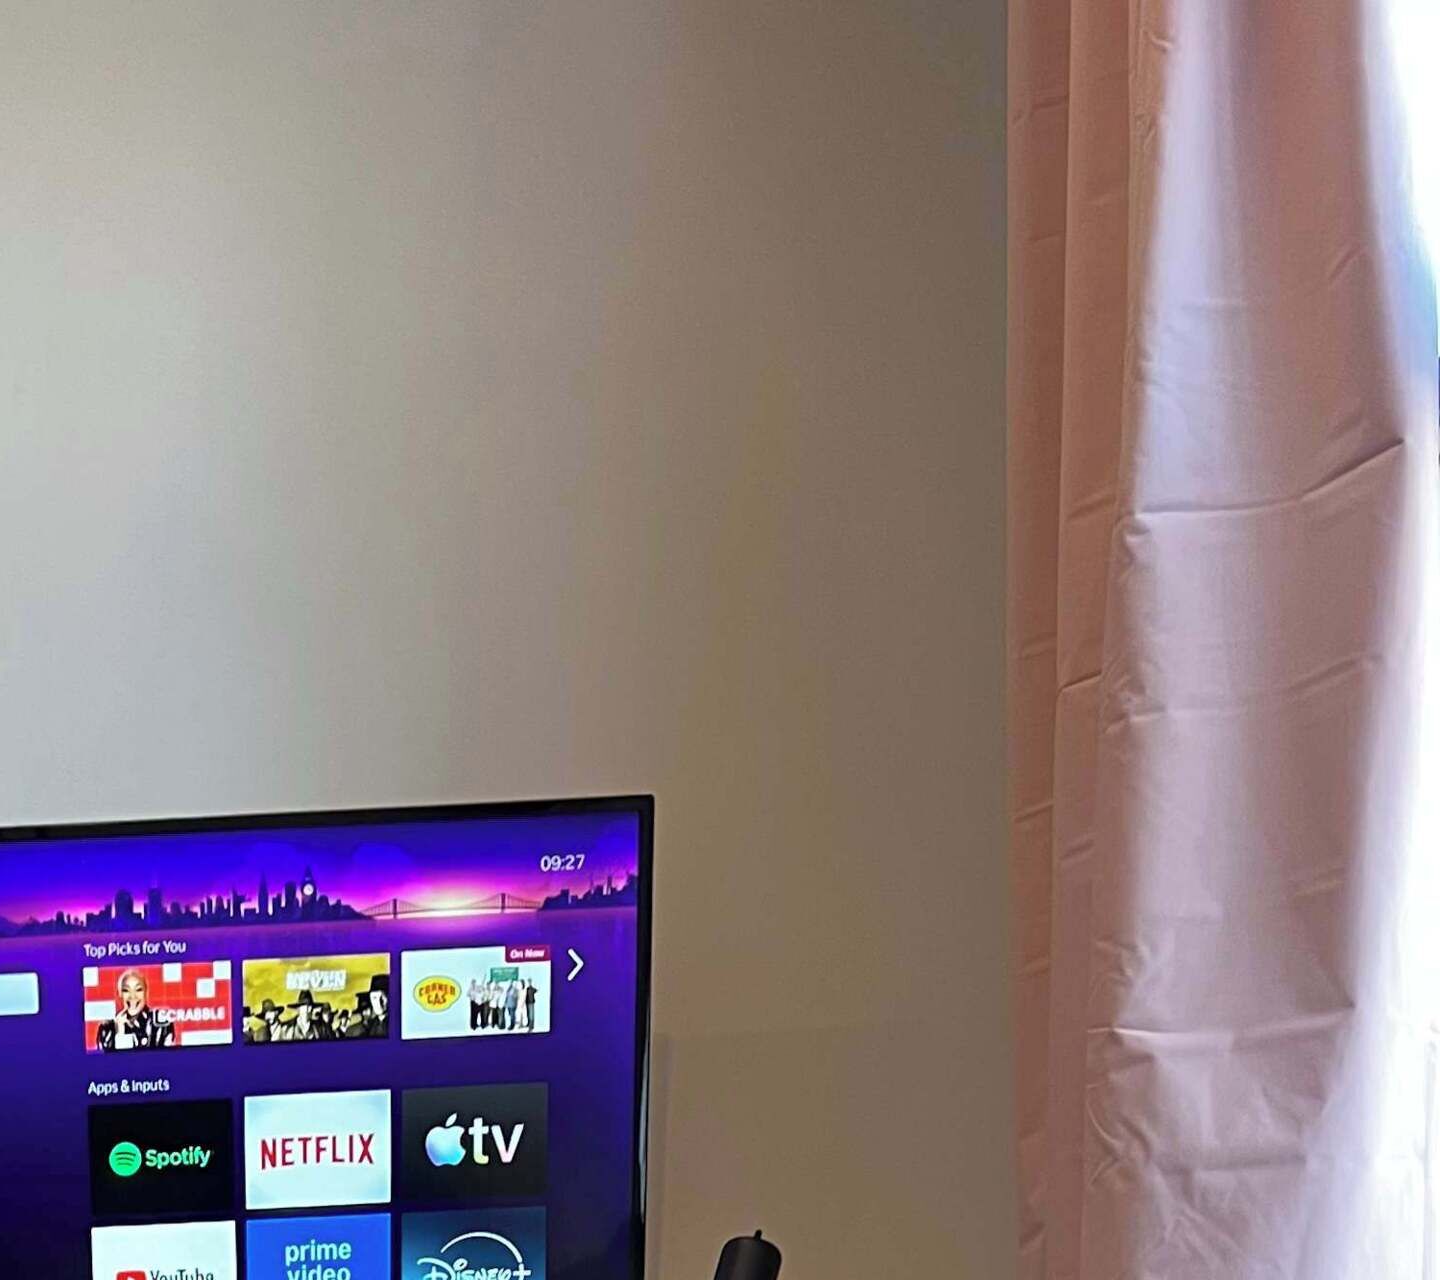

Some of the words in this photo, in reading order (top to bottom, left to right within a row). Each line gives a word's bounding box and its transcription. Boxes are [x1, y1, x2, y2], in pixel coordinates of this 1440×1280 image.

[540, 854, 585, 873] 09:27
[83, 943, 106, 959] Top
[108, 942, 140, 956] Picks
[142, 940, 160, 954] for
[162, 940, 187, 954] You
[510, 950, 523, 959] On
[157, 1006, 225, 1023] SCRABBLE
[87, 1079, 118, 1097] Apps
[120, 1080, 130, 1093] &
[132, 1077, 170, 1095] Inputs
[468, 1115, 524, 1164] tv
[145, 1145, 211, 1169] Spotify
[260, 1132, 375, 1171] NETFLIX
[285, 1240, 352, 1265] prime
